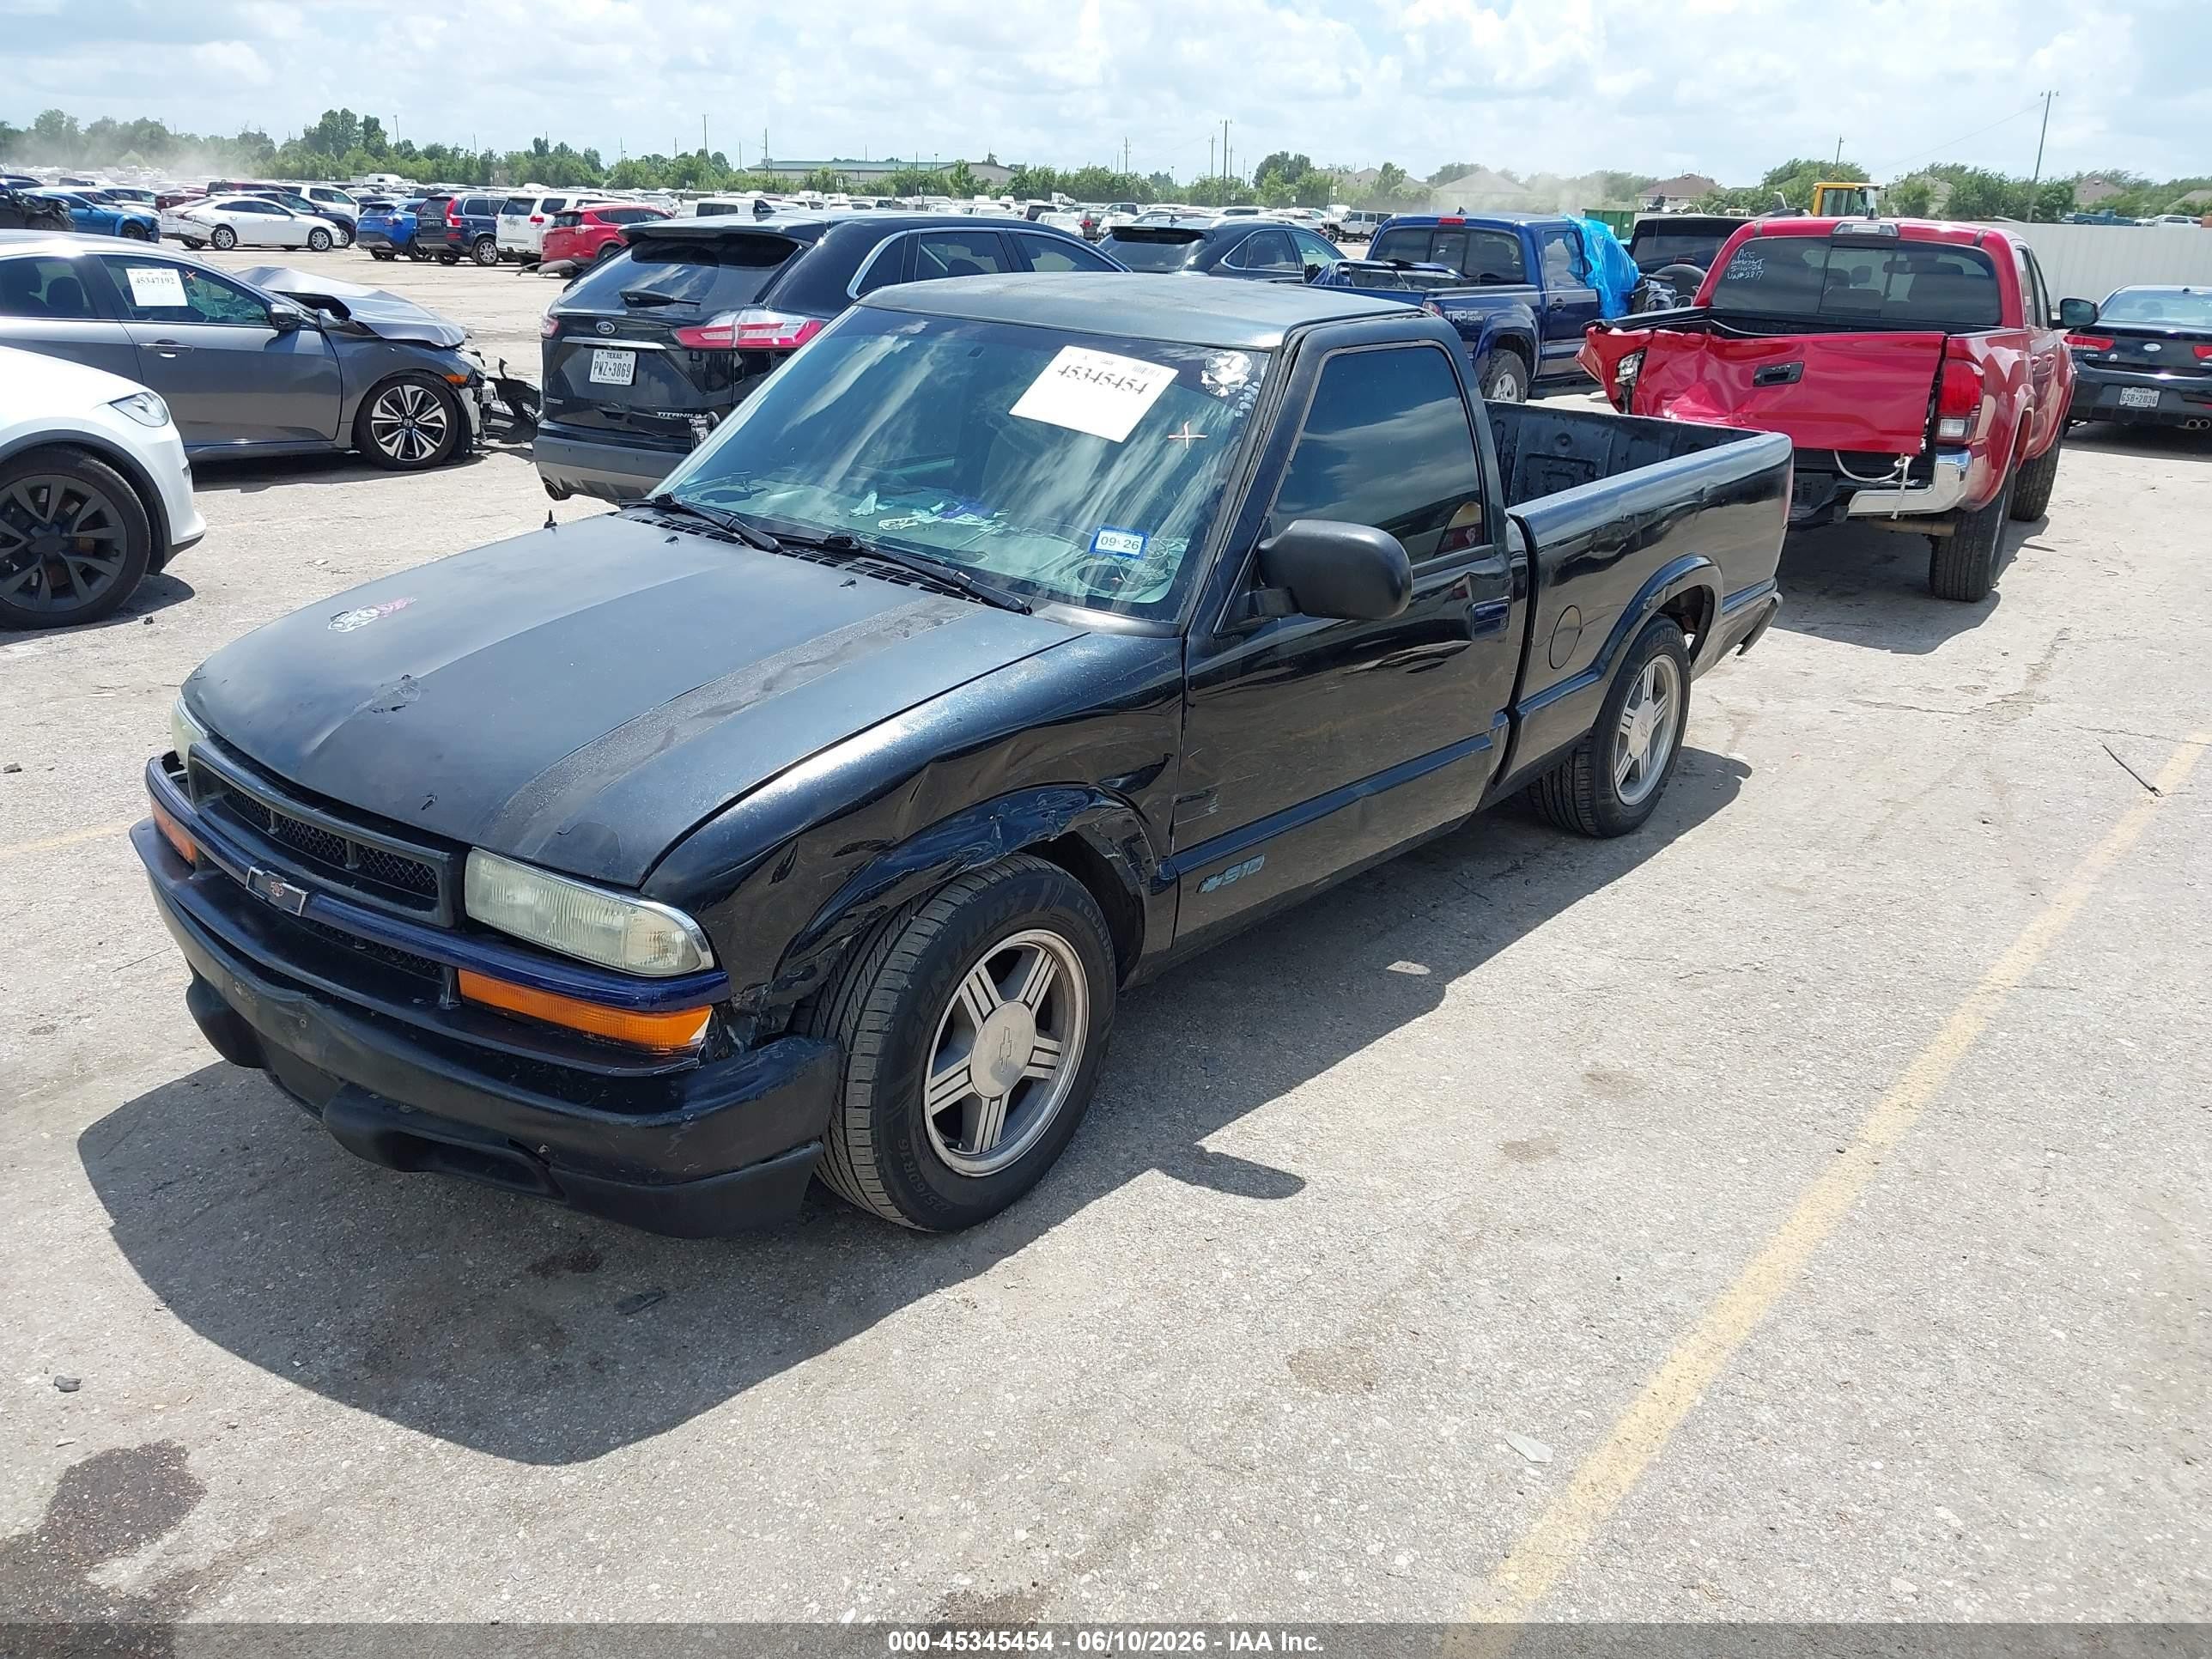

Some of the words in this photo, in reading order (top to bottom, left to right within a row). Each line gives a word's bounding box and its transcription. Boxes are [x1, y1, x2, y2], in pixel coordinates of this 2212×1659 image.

[1057, 364, 1150, 395] 45345454
[1100, 536, 1117, 547] 09
[1122, 538, 1140, 550] 26
